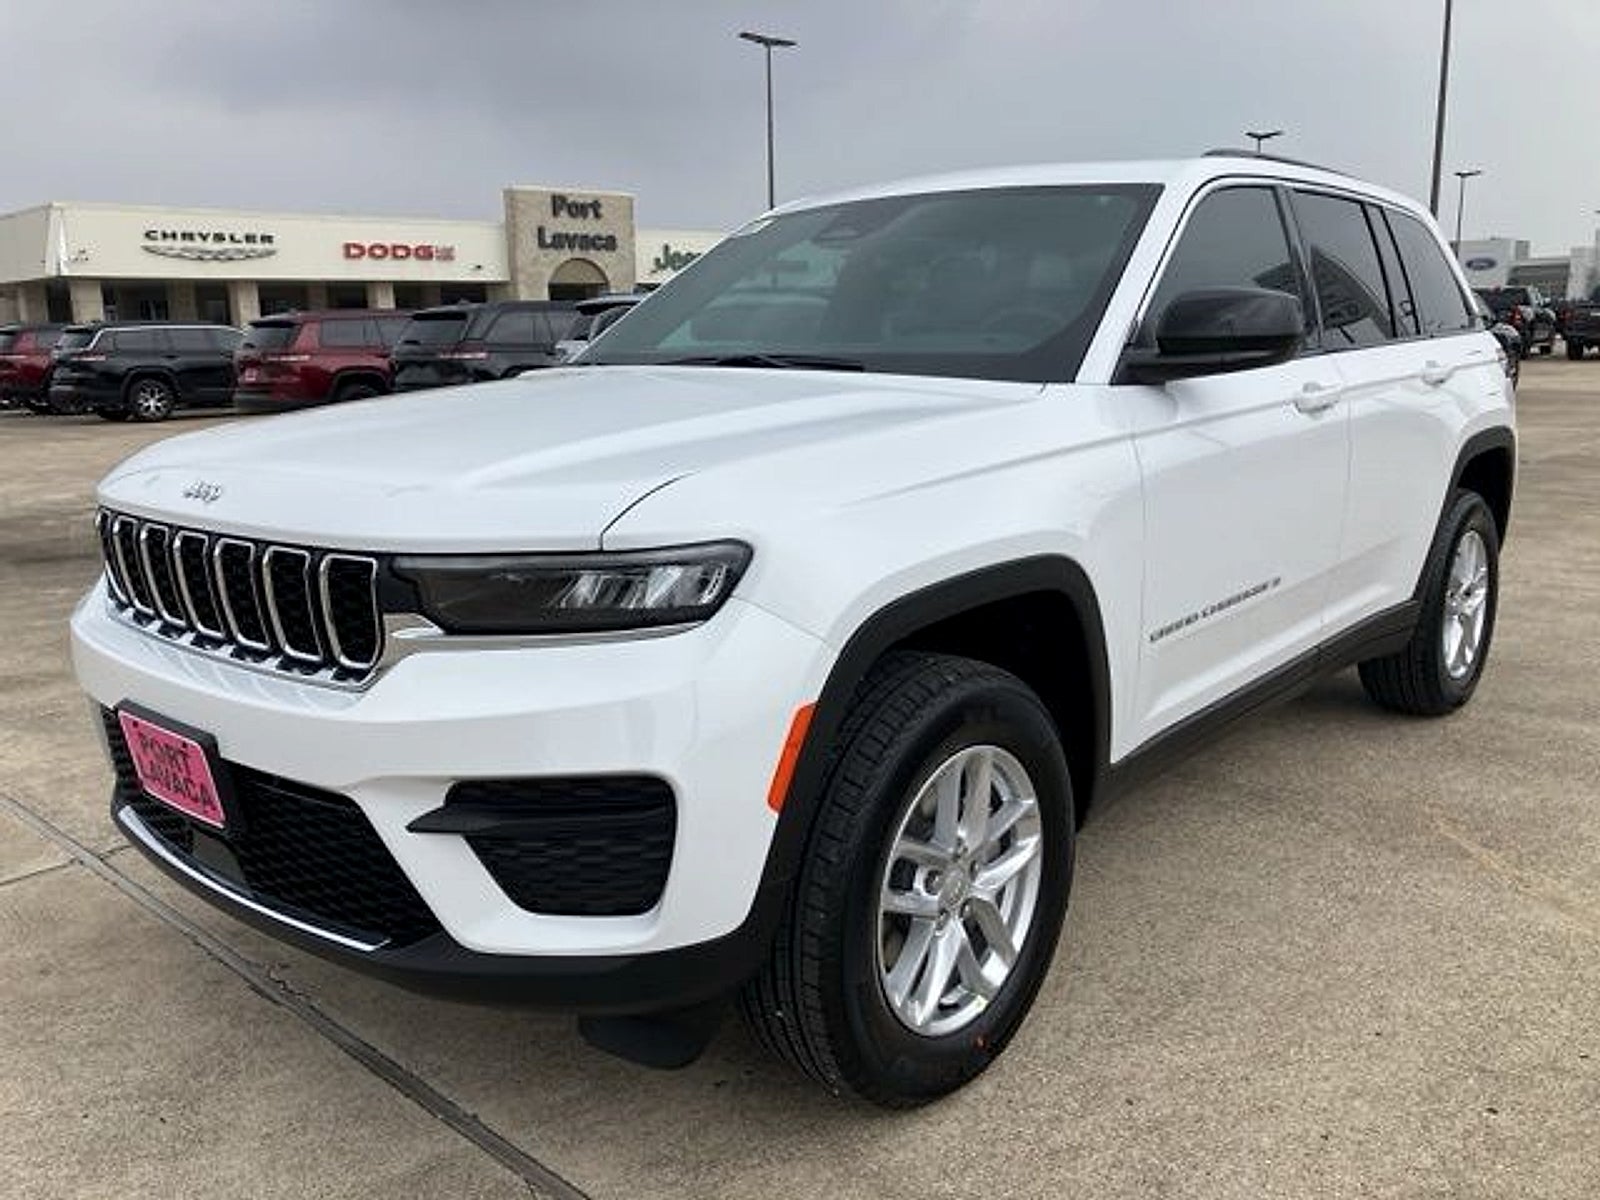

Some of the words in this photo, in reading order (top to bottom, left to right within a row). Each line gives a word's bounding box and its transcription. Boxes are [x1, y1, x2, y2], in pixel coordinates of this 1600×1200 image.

[551, 194, 602, 219] Port
[144, 229, 275, 244] CHRYSLER
[537, 226, 617, 251] Lavaca
[654, 244, 702, 270] Jee
[137, 731, 190, 776] PORT
